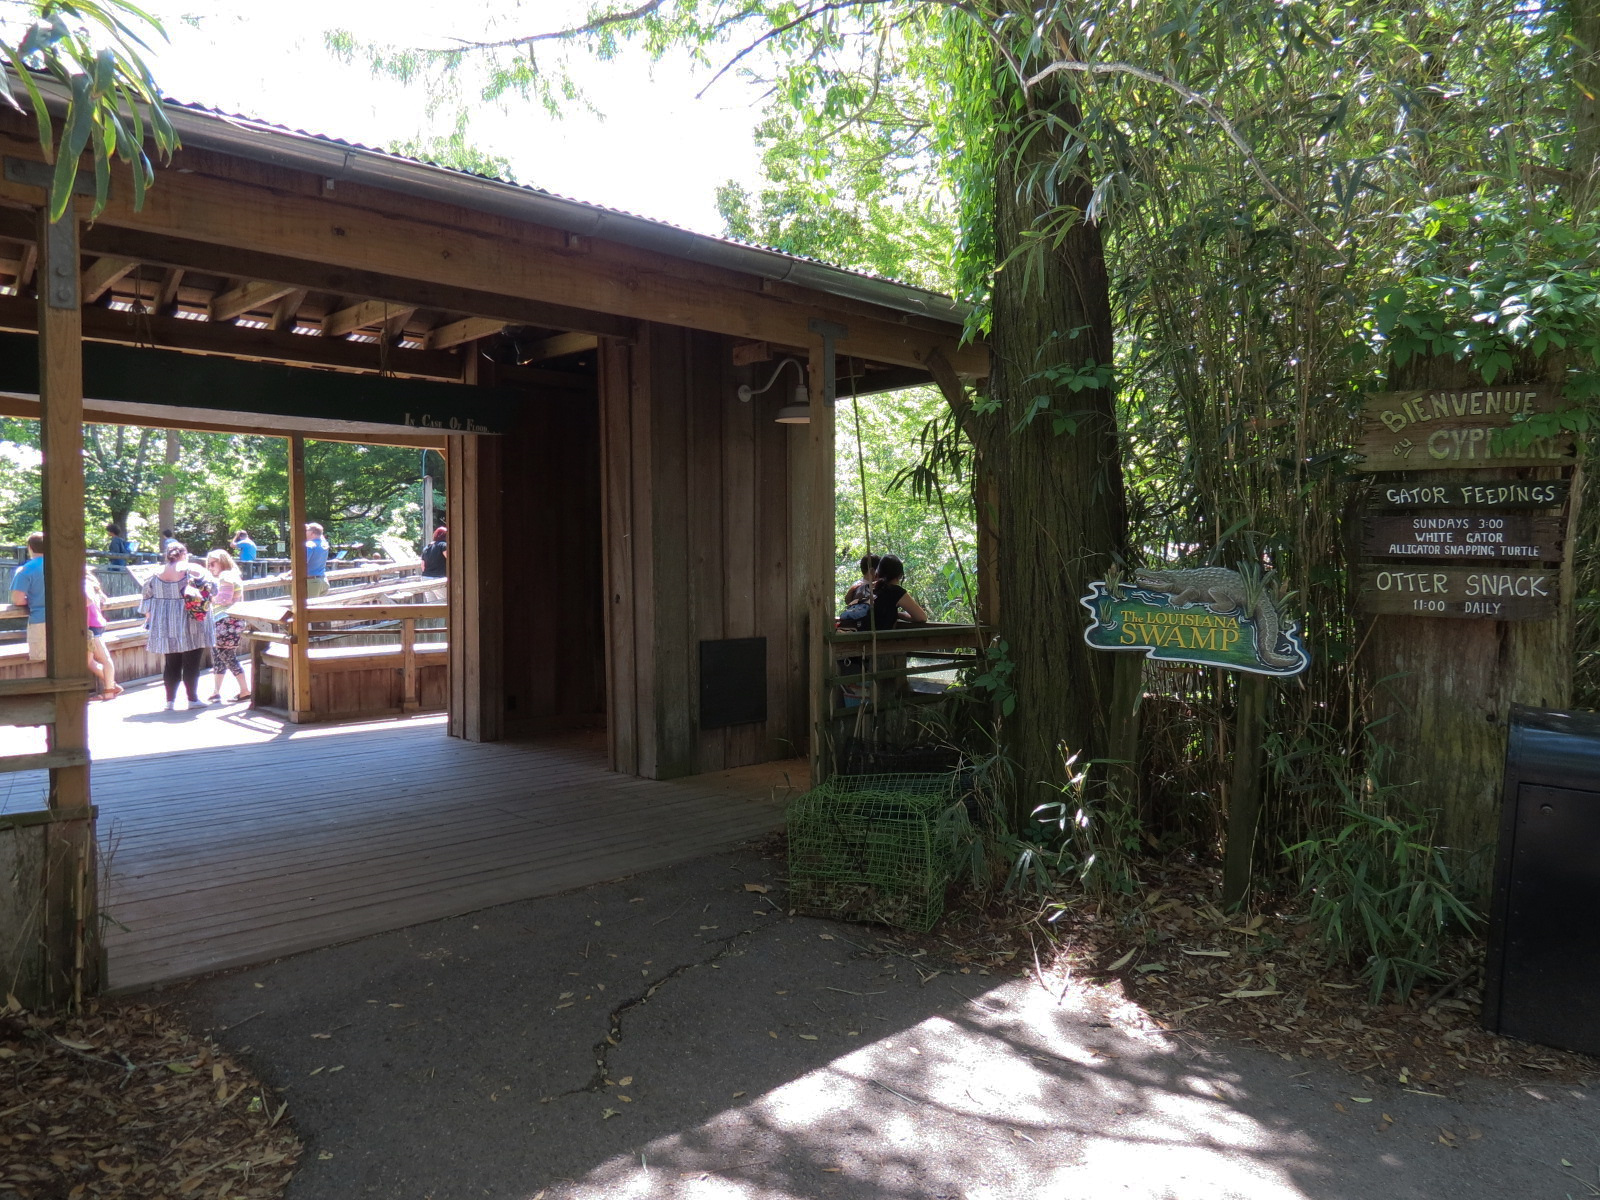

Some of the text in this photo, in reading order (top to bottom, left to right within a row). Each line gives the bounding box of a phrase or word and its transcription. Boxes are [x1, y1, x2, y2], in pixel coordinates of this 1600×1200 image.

[1380, 391, 1537, 433] BIENVENUE
[1387, 485, 1555, 505] GATOR FEEDINGS
[1413, 519, 1504, 529] SUNDAYS 3:00
[1415, 532, 1503, 543] WHITE GATOR
[1389, 544, 1539, 557] ALLIGATOR SNAPPING TURTLE
[1376, 571, 1548, 597] OTTER SNACK
[1413, 600, 1501, 614] 11:00 DAILY
[1121, 610, 1239, 629] The LOUISIANA
[1120, 622, 1240, 651] SWAMP
